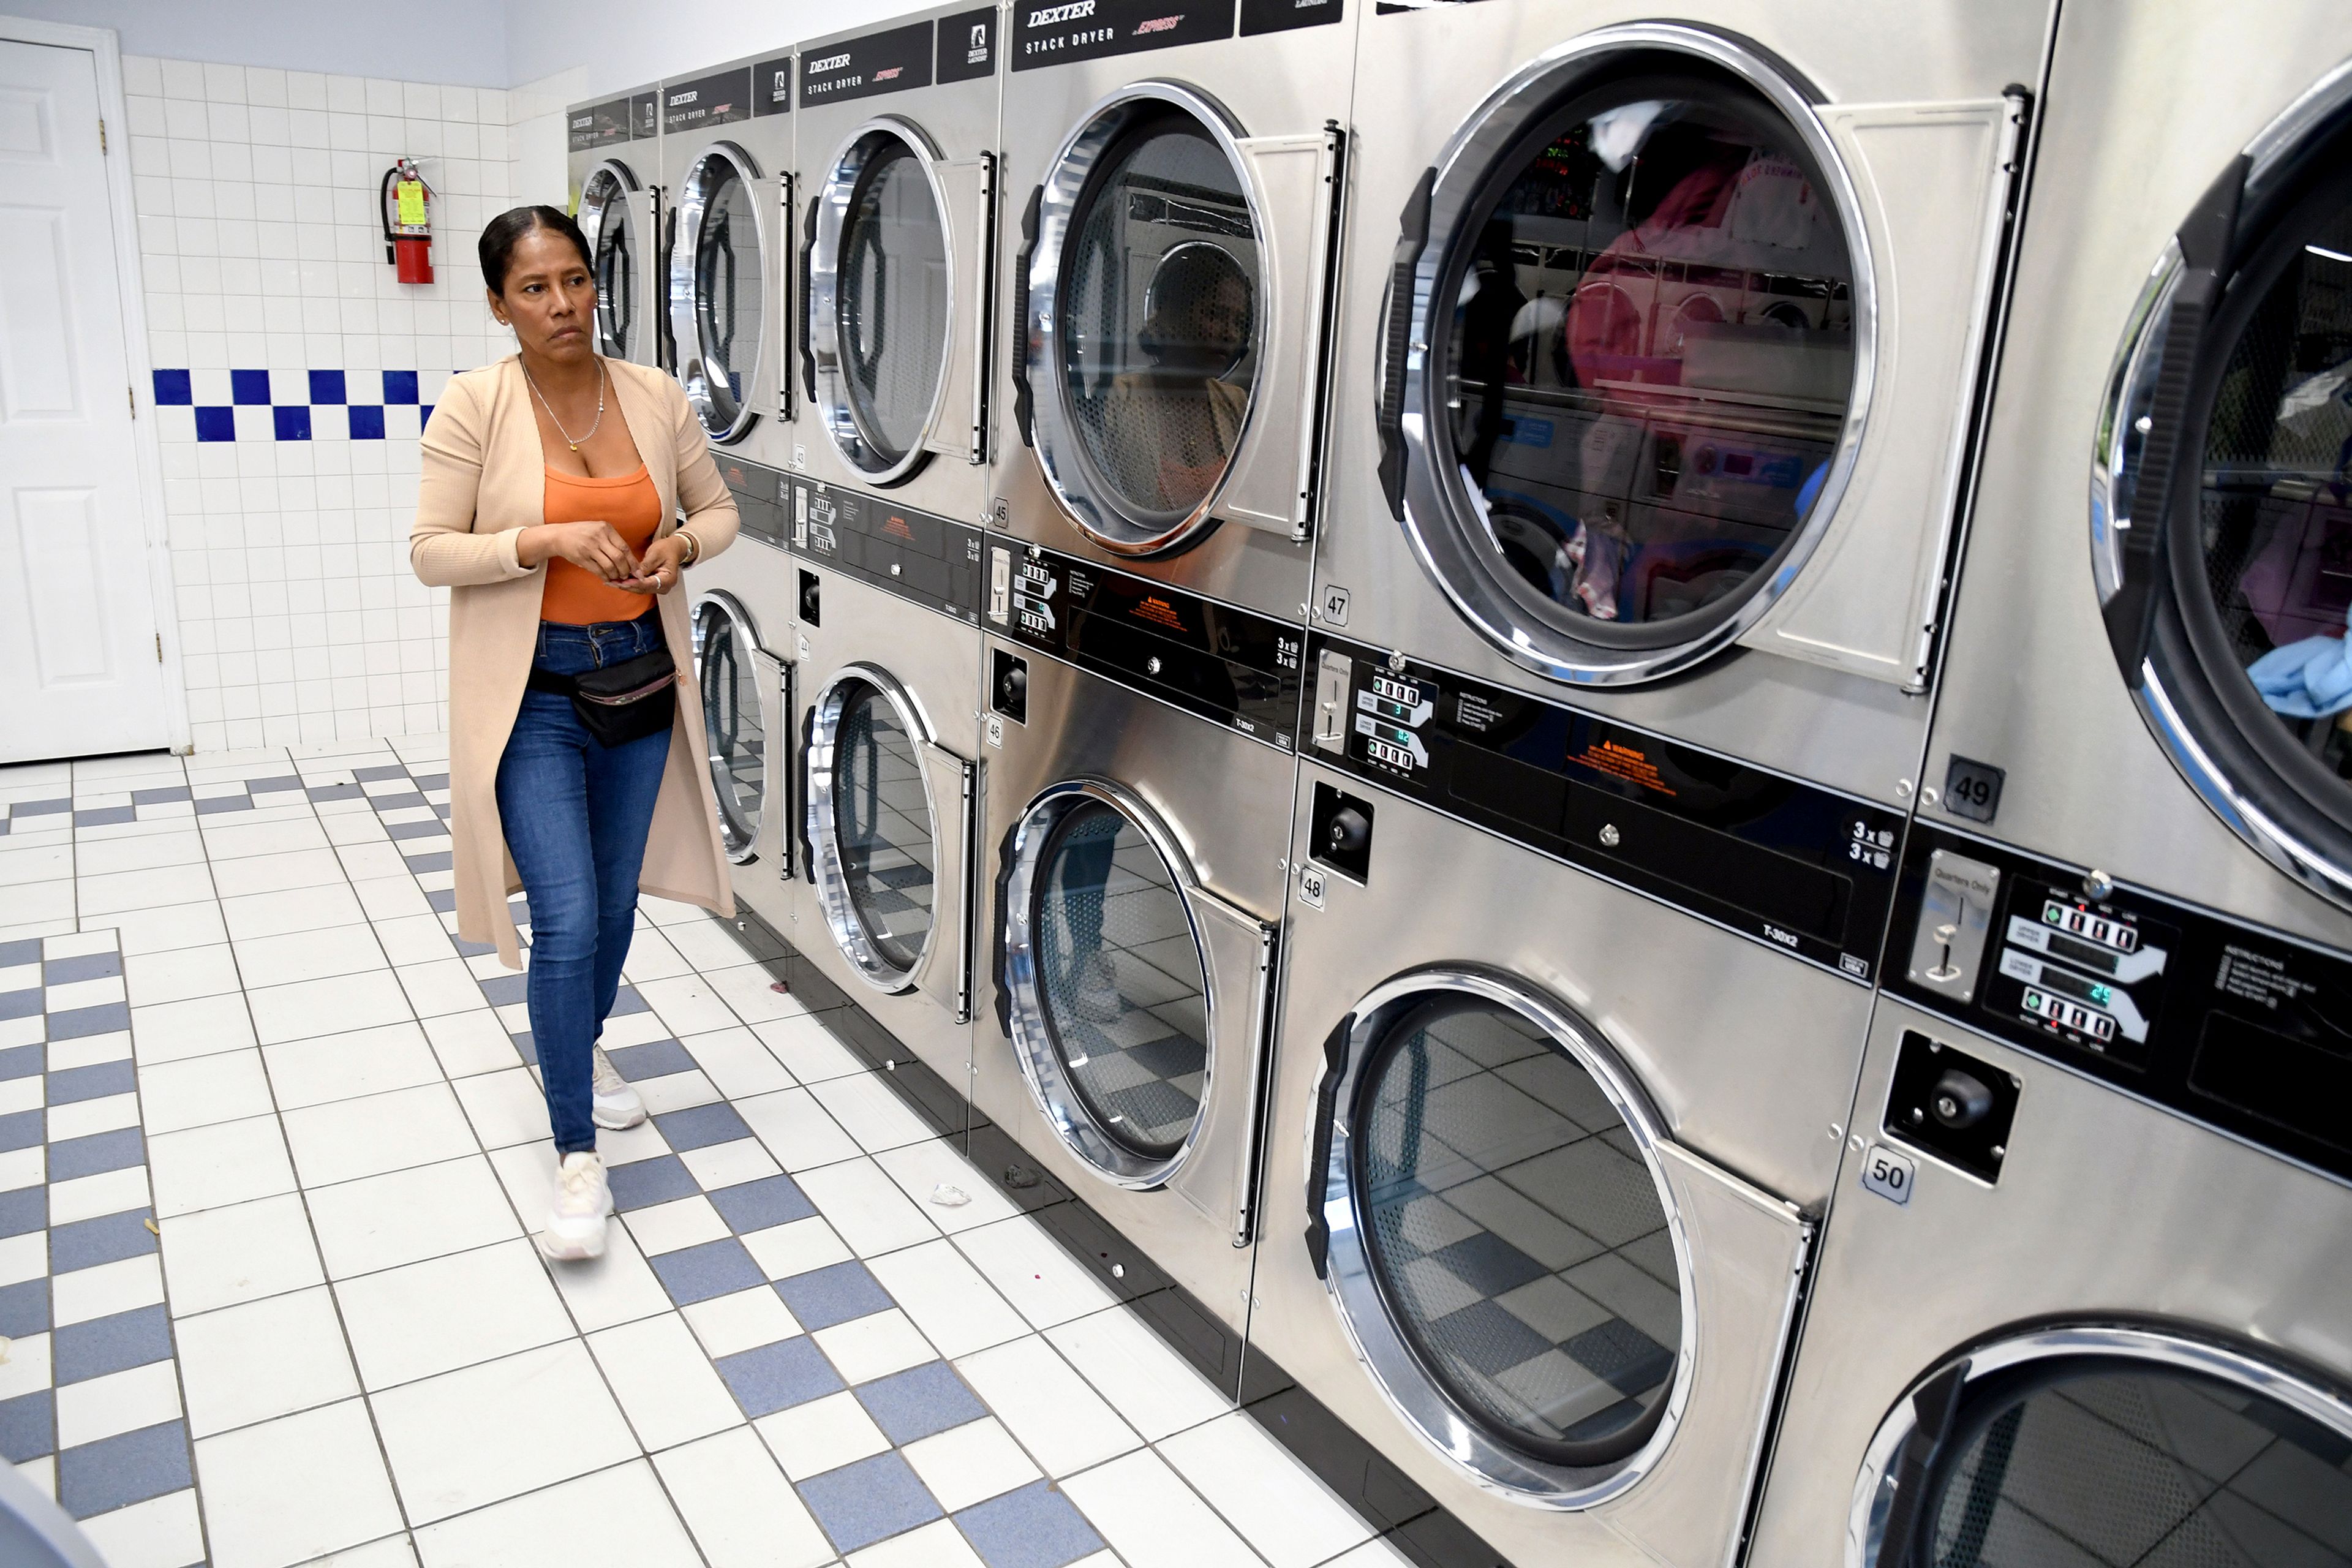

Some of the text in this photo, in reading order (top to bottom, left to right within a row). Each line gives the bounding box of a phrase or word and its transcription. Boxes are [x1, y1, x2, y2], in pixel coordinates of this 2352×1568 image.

[1027, 0, 1096, 28] DEXTER
[1026, 28, 1114, 55] STACK DRYER
[809, 53, 850, 74] DEXTER
[808, 75, 862, 95] STACK DRYER
[669, 91, 698, 106] DEXTER
[669, 113, 685, 124] STACK
[688, 109, 706, 120] DRYER
[996, 505, 1006, 520] 45
[1328, 596, 1345, 615] 47
[1278, 636, 1284, 649] 3
[1276, 652, 1283, 664] 3
[1396, 704, 1401, 714] 3
[990, 724, 1000, 739] 46
[1954, 776, 1989, 806] 49
[1853, 821, 1865, 838] 3
[1849, 843, 1861, 859] 3
[1305, 878, 1320, 897] 48
[1935, 868, 1990, 895] Quarters Only
[1872, 1158, 1904, 1189] 50
